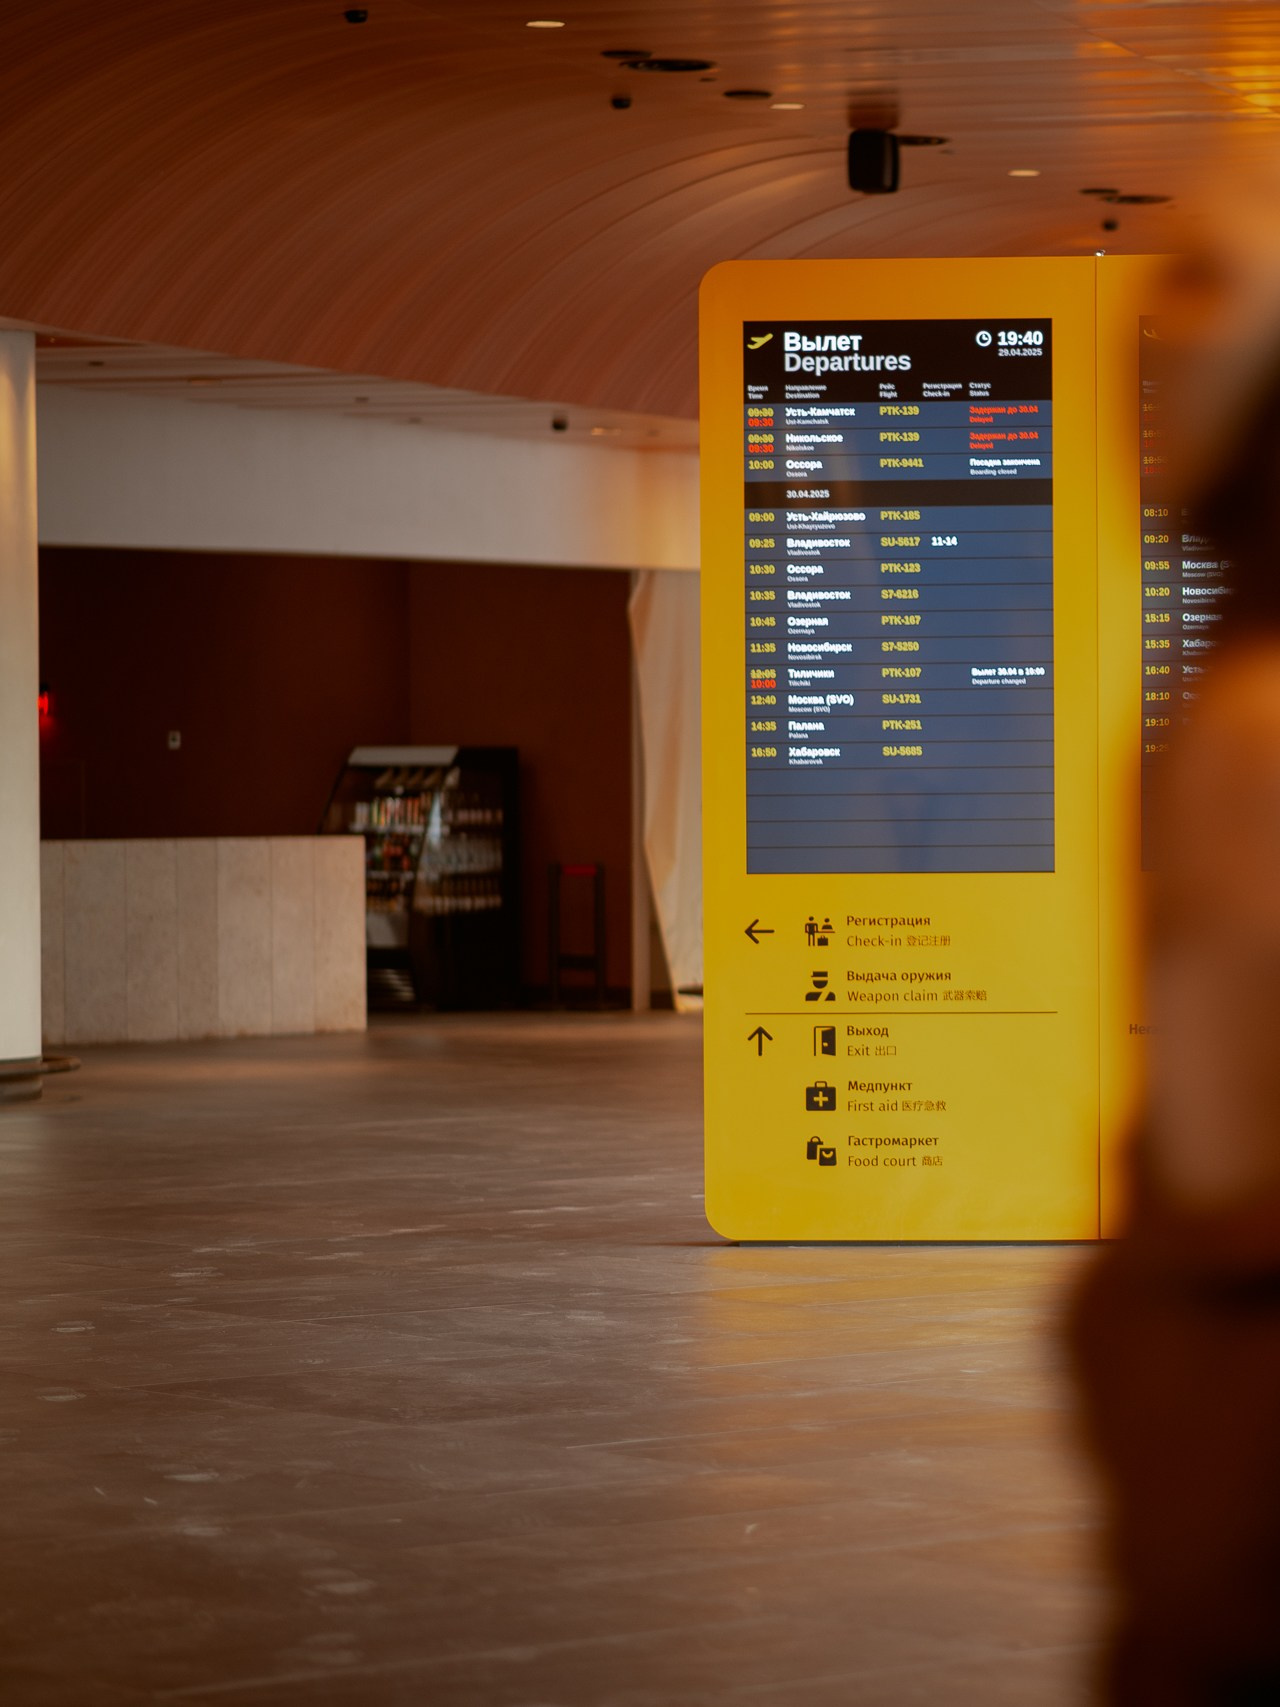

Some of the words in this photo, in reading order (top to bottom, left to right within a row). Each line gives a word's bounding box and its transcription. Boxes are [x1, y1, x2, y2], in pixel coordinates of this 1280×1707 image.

[784, 331, 862, 351] Вылет
[998, 331, 1043, 346] 19:40
[998, 348, 1042, 356] 29.04.2025
[785, 352, 911, 375] Departures
[923, 382, 962, 390] Регистрация
[970, 382, 991, 390] Статус
[879, 391, 897, 399] Flight
[923, 390, 950, 398] Check-in
[785, 407, 855, 417] Усть-Камчатск
[748, 418, 774, 427] 09:30
[786, 434, 843, 443] Никольское
[748, 444, 774, 453] 09:30
[748, 460, 774, 469] 10:00
[786, 460, 823, 470] Оссора
[970, 458, 1002, 467] Посадка
[786, 490, 830, 498] 30.04.2025
[749, 513, 775, 522] 09:00
[786, 511, 866, 522] Усть-Хайрюзово
[1144, 508, 1168, 517] 08:10
[749, 539, 775, 548] 09:25
[787, 538, 851, 549] Владивосток
[931, 536, 958, 546] 11-14
[1144, 535, 1169, 544] 09:20
[750, 565, 775, 574] 10:30
[787, 564, 823, 575] Оссора
[1144, 561, 1170, 570] 09:55
[1182, 560, 1218, 570] Москва
[750, 591, 776, 600] 10:35
[787, 591, 851, 602] Владивосток
[1145, 587, 1170, 596] 10:20
[750, 617, 776, 627] 10:45
[787, 617, 829, 628] Озерная
[1145, 613, 1170, 623] 15:15
[750, 643, 776, 653] 11:35
[788, 642, 852, 654] Новосибирск
[1145, 639, 1170, 649] 15:35
[788, 669, 834, 678] Тиличики
[971, 667, 996, 676] Вылет
[997, 667, 1017, 676] 30.04
[1018, 668, 1024, 676] в
[1145, 666, 1170, 675] 16:40
[751, 680, 776, 688] 10:00
[751, 695, 776, 705] 12:40
[788, 695, 824, 704] Москва
[826, 694, 854, 706] (SVO)
[882, 694, 921, 704] SU-1731
[1145, 692, 1170, 701] 18:10
[751, 721, 777, 731] 14:35
[788, 721, 824, 730] Палана
[1145, 718, 1170, 727] 19:10
[752, 748, 777, 757] 16:50
[788, 747, 840, 758] Хабаровск
[846, 915, 931, 928] Регистрация
[847, 934, 902, 947] Check-in
[907, 935, 951, 947] 登记注册
[847, 971, 897, 983] Выдача
[901, 972, 951, 983] оружия
[847, 990, 899, 1004] Weapon
[904, 989, 938, 1001] claim
[847, 1025, 889, 1037] Выход
[847, 1044, 870, 1056] Exit
[875, 1045, 897, 1056] 出口
[848, 1081, 912, 1093] Медпункт
[848, 1100, 874, 1112] First
[878, 1100, 898, 1112] aid
[902, 1100, 946, 1112] 医疗急救
[848, 1135, 939, 1148] Гастромаркет
[848, 1156, 878, 1167] Food
[883, 1157, 916, 1167] court
[922, 1156, 943, 1166] 商店
